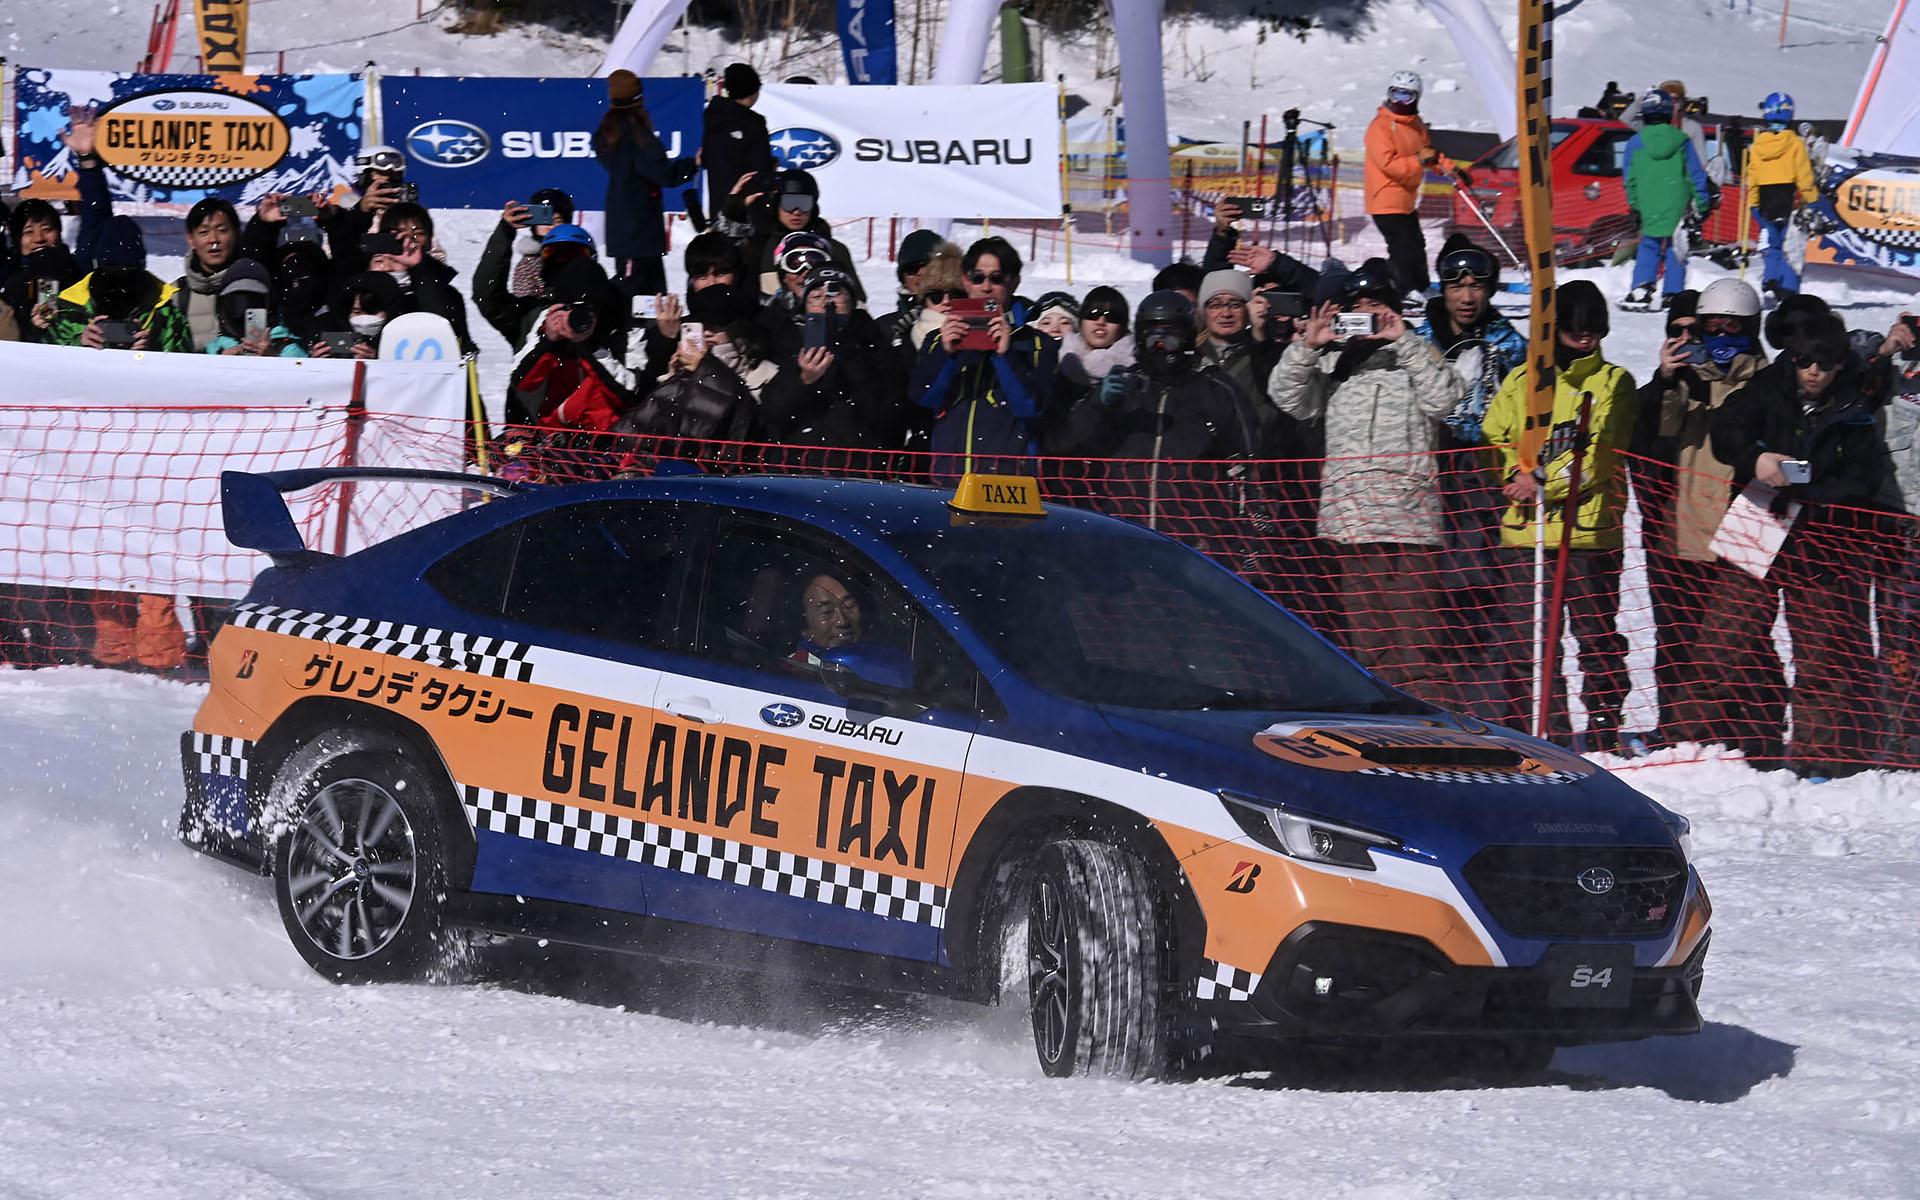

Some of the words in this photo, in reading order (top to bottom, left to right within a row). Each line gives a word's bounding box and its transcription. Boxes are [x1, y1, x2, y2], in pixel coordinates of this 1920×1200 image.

[179, 101, 230, 110] SUBARU
[107, 118, 212, 150] GELANDE
[224, 121, 274, 151] TAXI
[501, 131, 682, 158] SUBU
[855, 138, 1032, 165] SUBARU
[981, 483, 1027, 505] TAXI
[304, 653, 534, 724] ゲレンデタクシー
[808, 714, 904, 746] SUBARU
[542, 703, 787, 839] GELANDE
[812, 755, 937, 870] TAXI
[1570, 967, 1613, 988] S4
